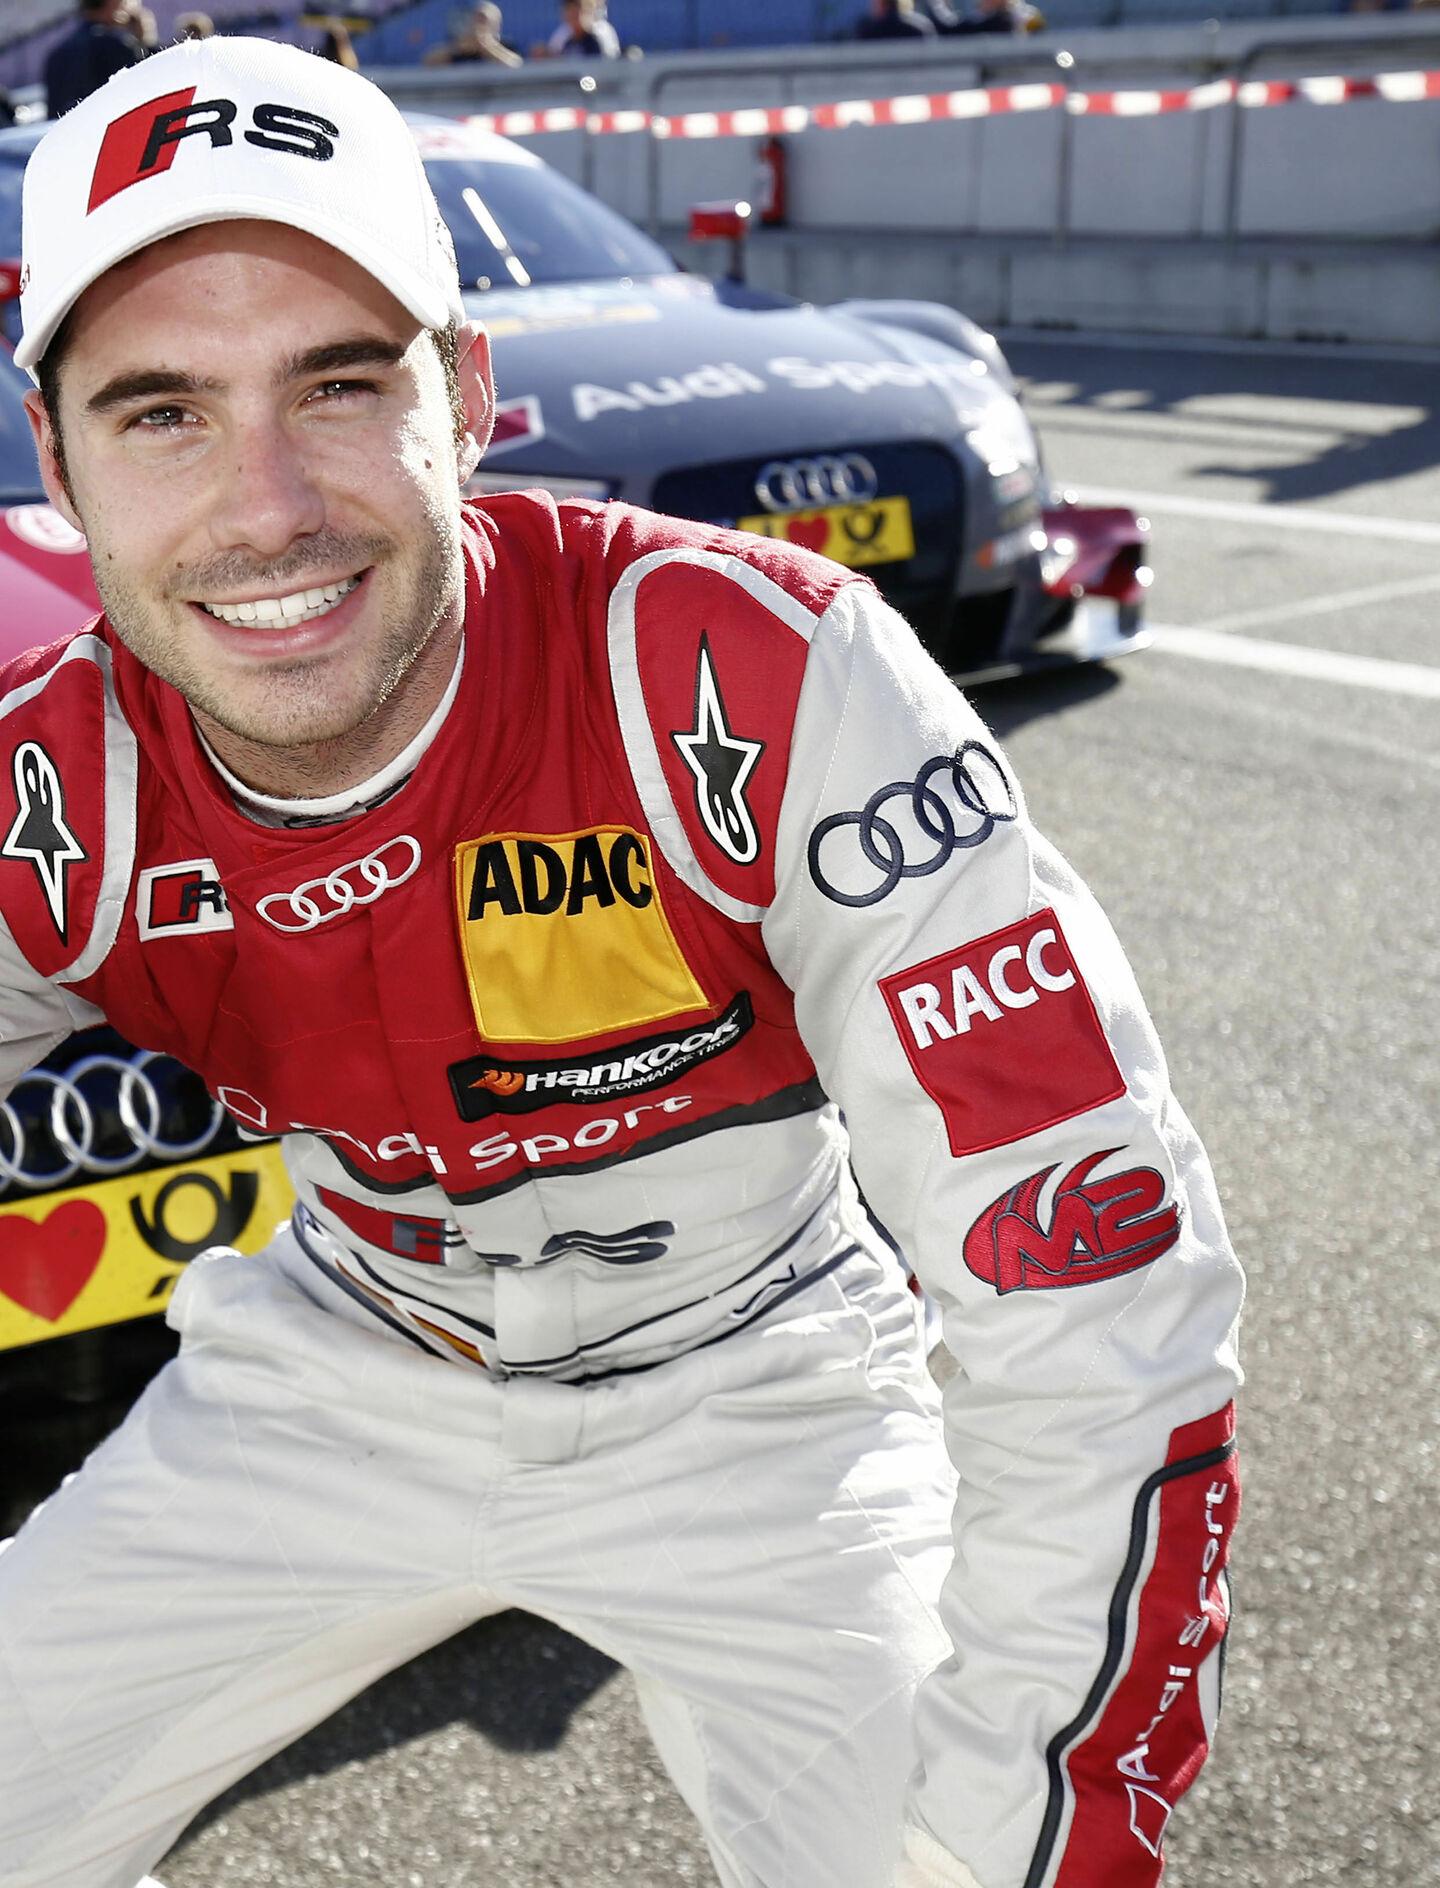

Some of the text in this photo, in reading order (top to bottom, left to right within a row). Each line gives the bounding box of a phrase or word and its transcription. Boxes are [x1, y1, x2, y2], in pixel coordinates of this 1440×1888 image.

[137, 98, 340, 162] RS
[571, 362, 767, 423] Audi
[466, 832, 653, 921] ADAC
[897, 928, 1077, 1051] RACC
[571, 1051, 696, 1098] PERFORMANCE
[468, 1095, 693, 1170] Sport
